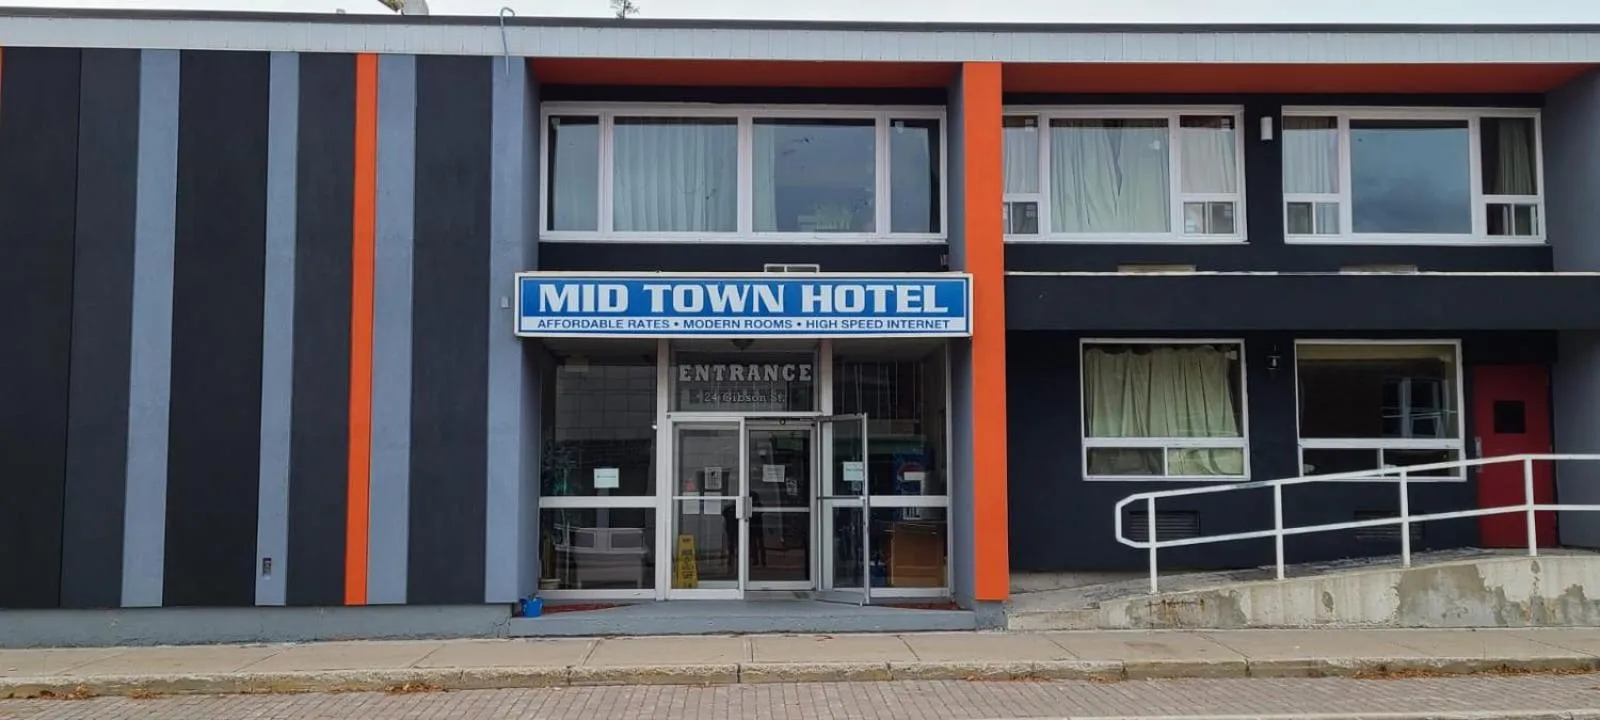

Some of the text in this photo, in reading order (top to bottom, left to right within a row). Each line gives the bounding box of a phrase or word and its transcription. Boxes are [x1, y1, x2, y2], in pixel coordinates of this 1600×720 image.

[539, 284, 948, 313] MID TOWN HOTEL
[537, 319, 951, 330] AFFORDABLE RATES MODERN ROOMS HIGH SPEED INTERNET
[679, 364, 812, 381] ENTRANCE
[704, 392, 717, 402] 24
[721, 391, 767, 402] Gibson
